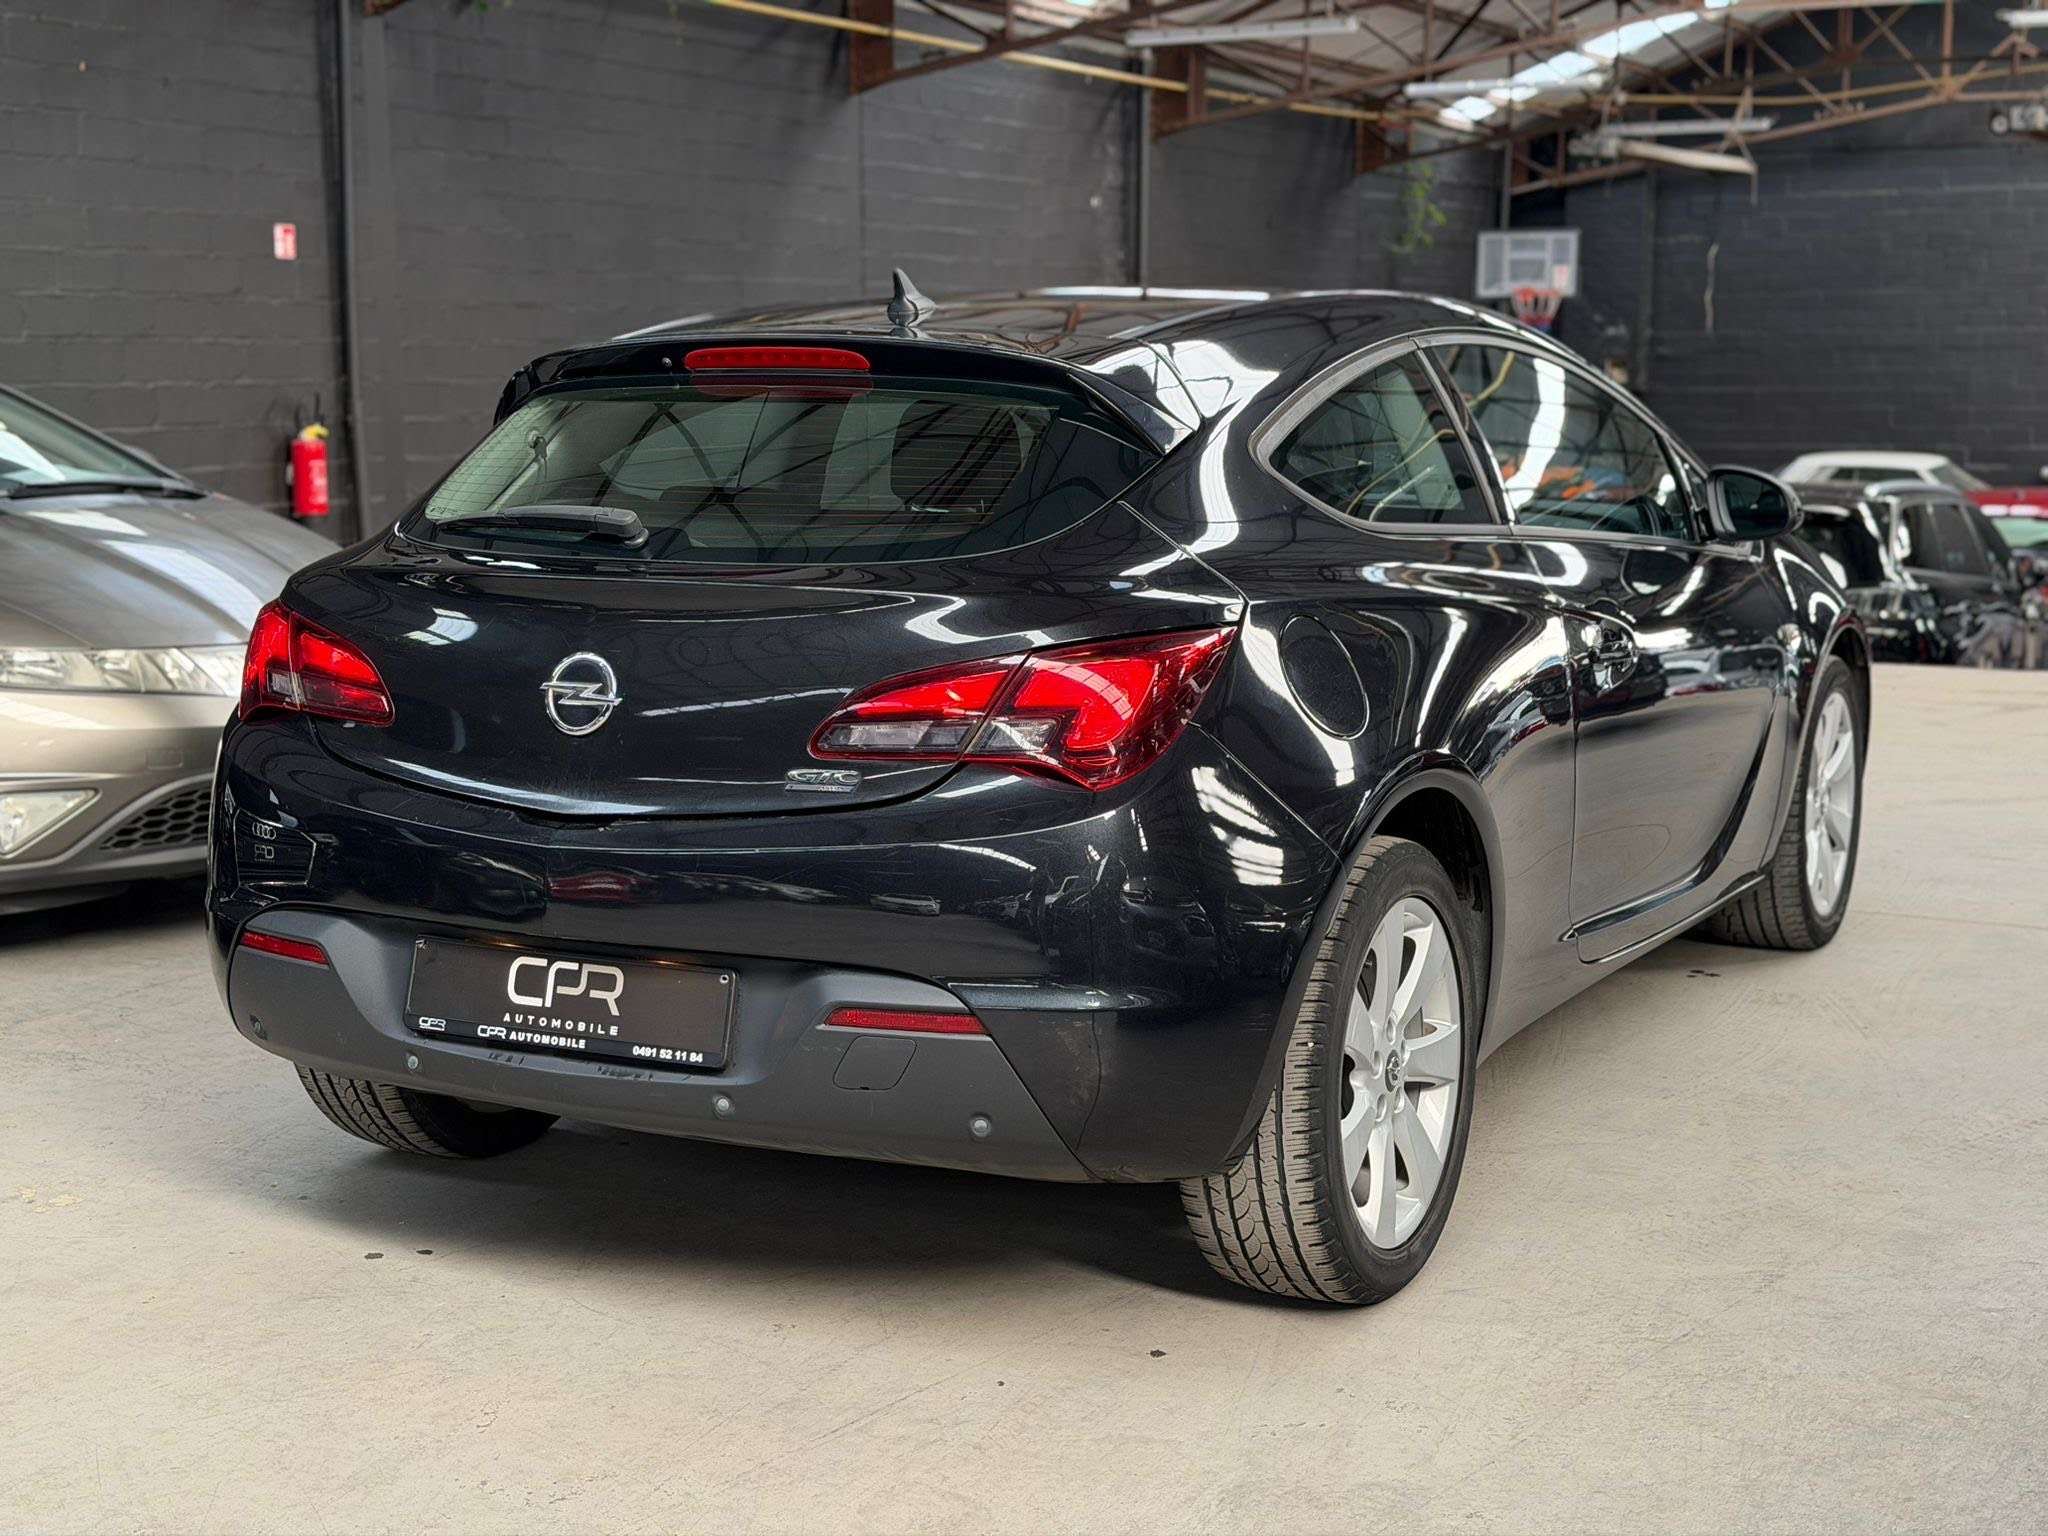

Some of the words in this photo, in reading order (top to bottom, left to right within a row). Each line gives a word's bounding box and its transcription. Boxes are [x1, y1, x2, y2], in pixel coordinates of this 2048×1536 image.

[507, 956, 625, 1016] CPR
[503, 1012, 619, 1036] AUTOMOBILE
[477, 1025, 507, 1039] CPR
[509, 1030, 586, 1049] AUTOMOBILE
[632, 1045, 657, 1058] 0491
[659, 1048, 673, 1060] 52
[674, 1050, 687, 1062] 11
[689, 1052, 703, 1063] 84
